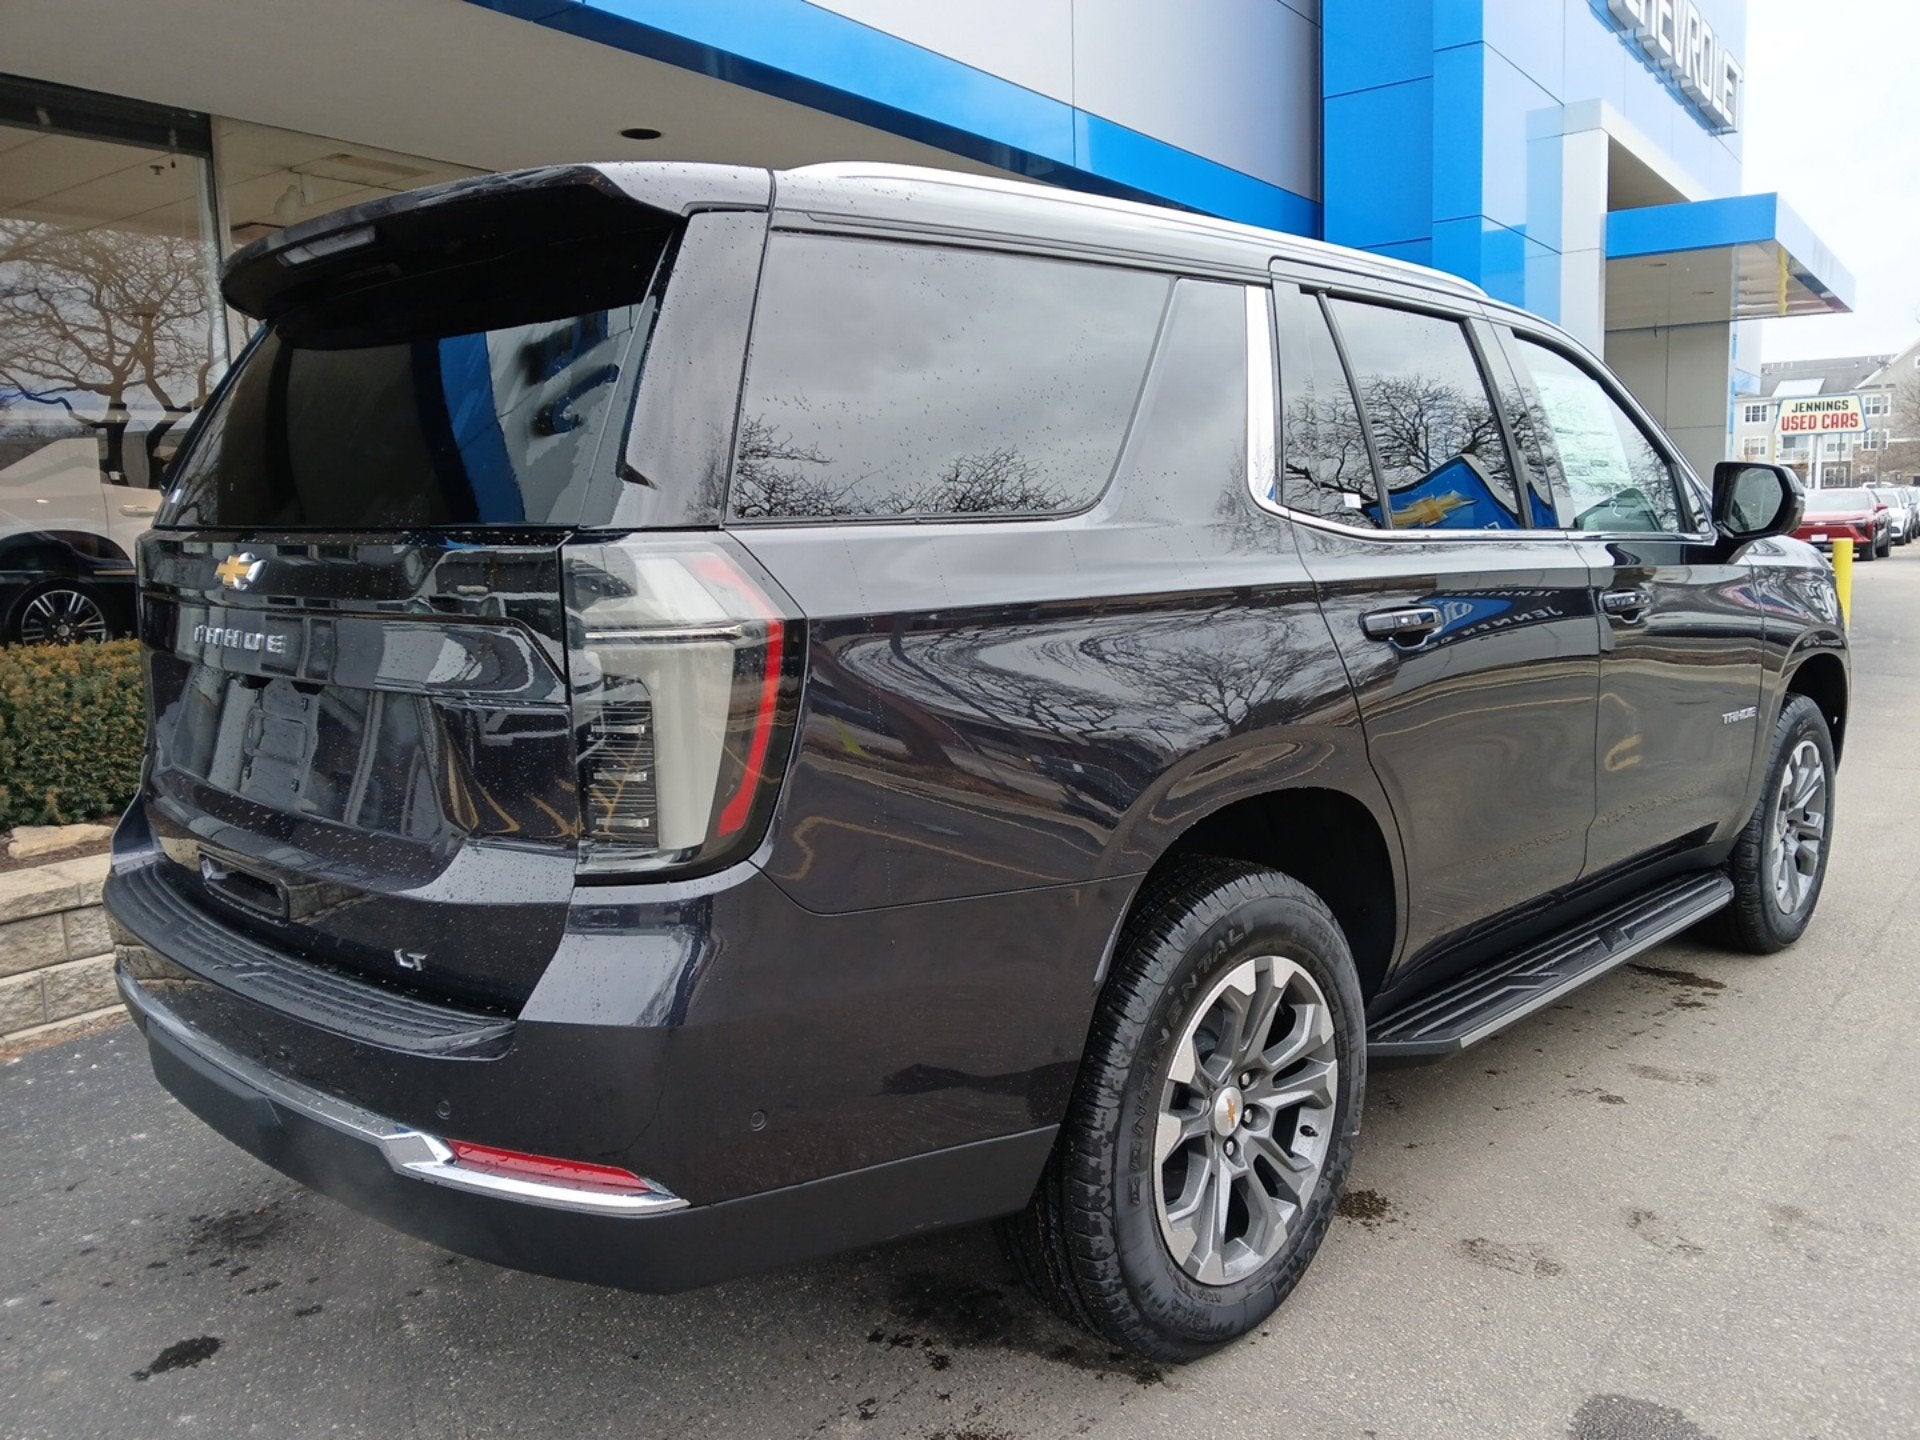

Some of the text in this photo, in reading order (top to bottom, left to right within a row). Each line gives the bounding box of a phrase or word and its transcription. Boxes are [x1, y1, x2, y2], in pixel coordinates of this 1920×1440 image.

[1791, 400, 1849, 413] JENNINGS
[1781, 412, 1859, 431] USED CARS
[394, 949, 428, 971] LT
